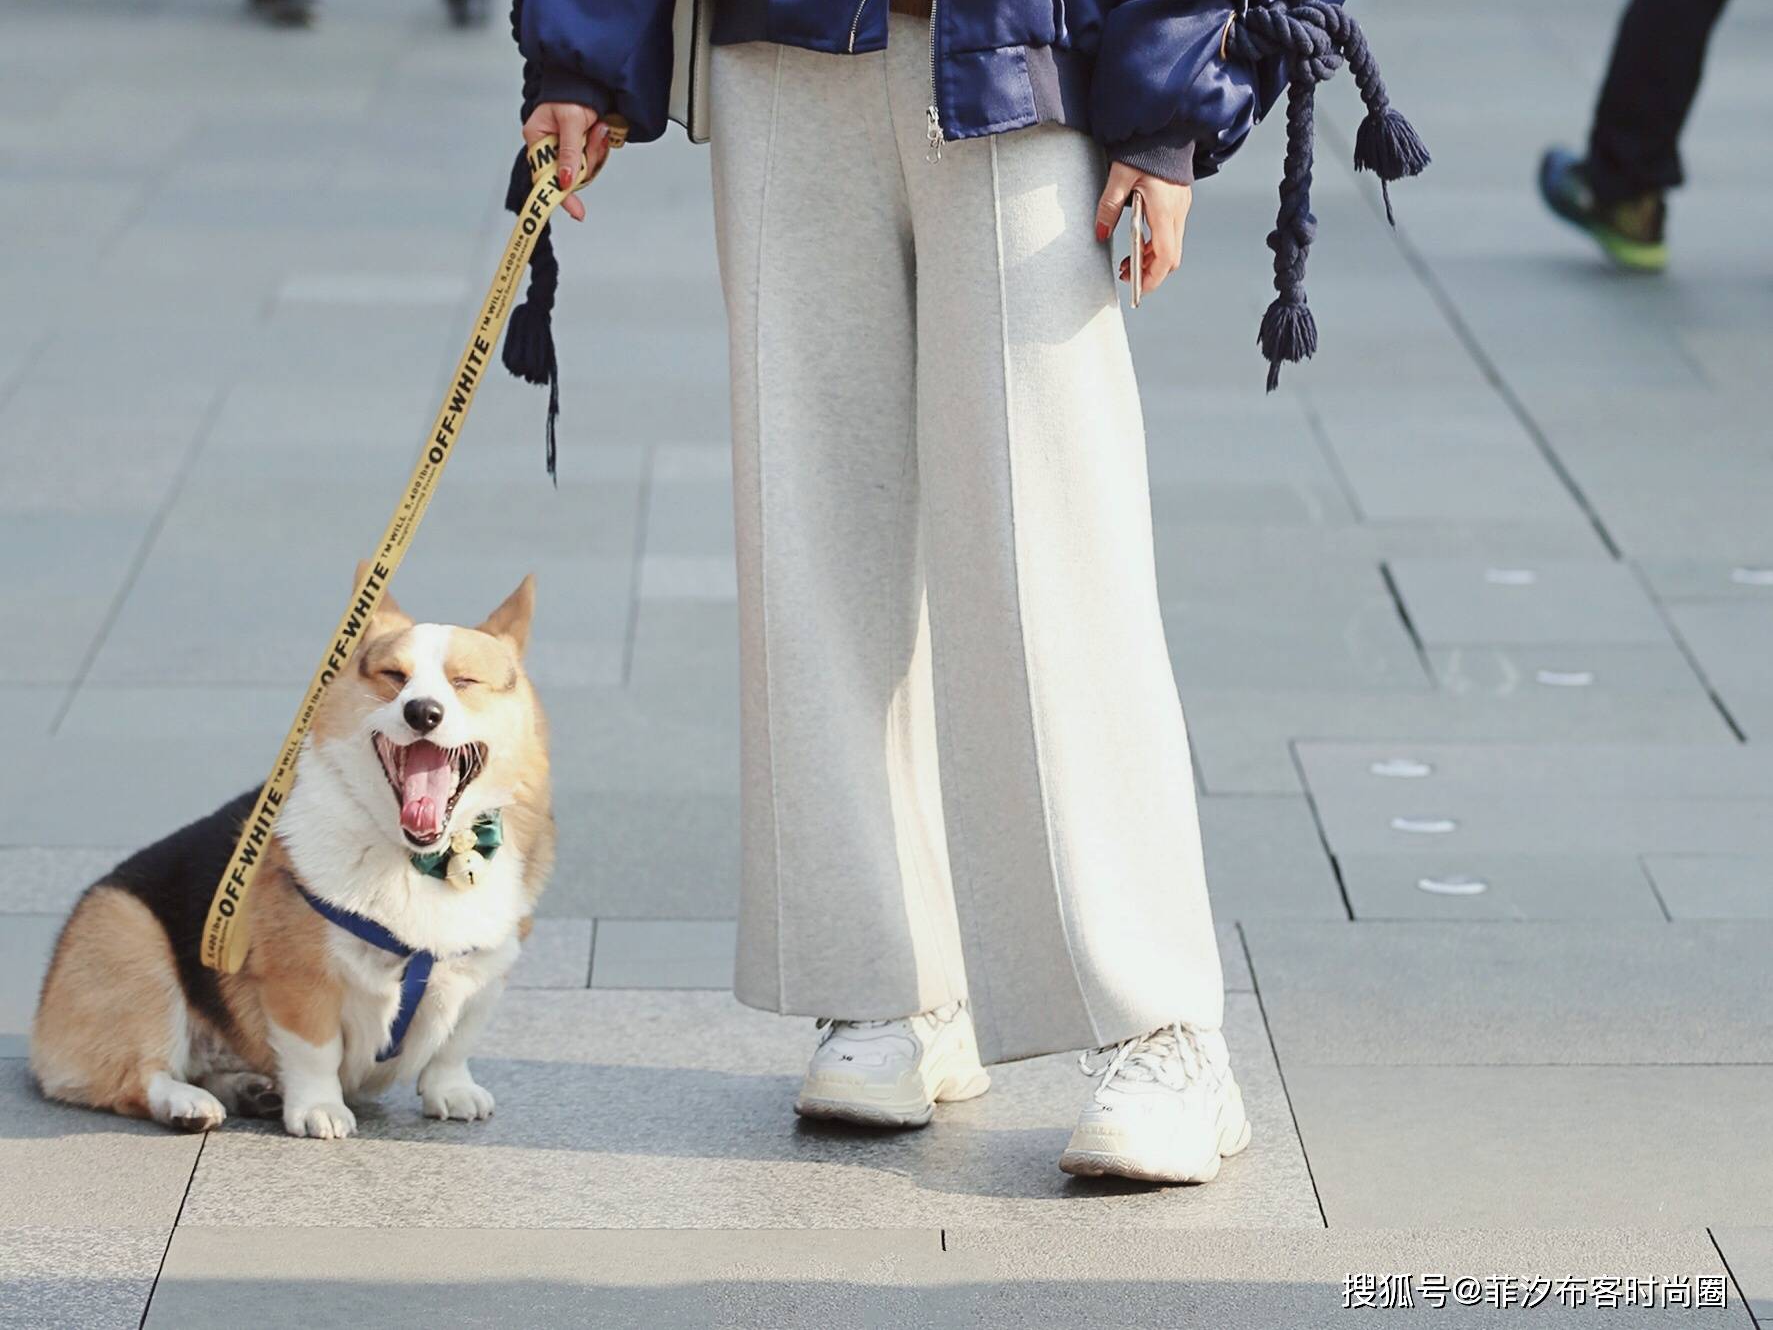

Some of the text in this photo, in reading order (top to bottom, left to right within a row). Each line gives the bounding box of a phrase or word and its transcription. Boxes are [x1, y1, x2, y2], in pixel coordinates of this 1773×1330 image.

[429, 335, 490, 464] OFF-WHITE
[489, 287, 503, 314] WILL
[321, 562, 389, 686] OFF-WHITE
[219, 786, 283, 917] OFF-WHITE
